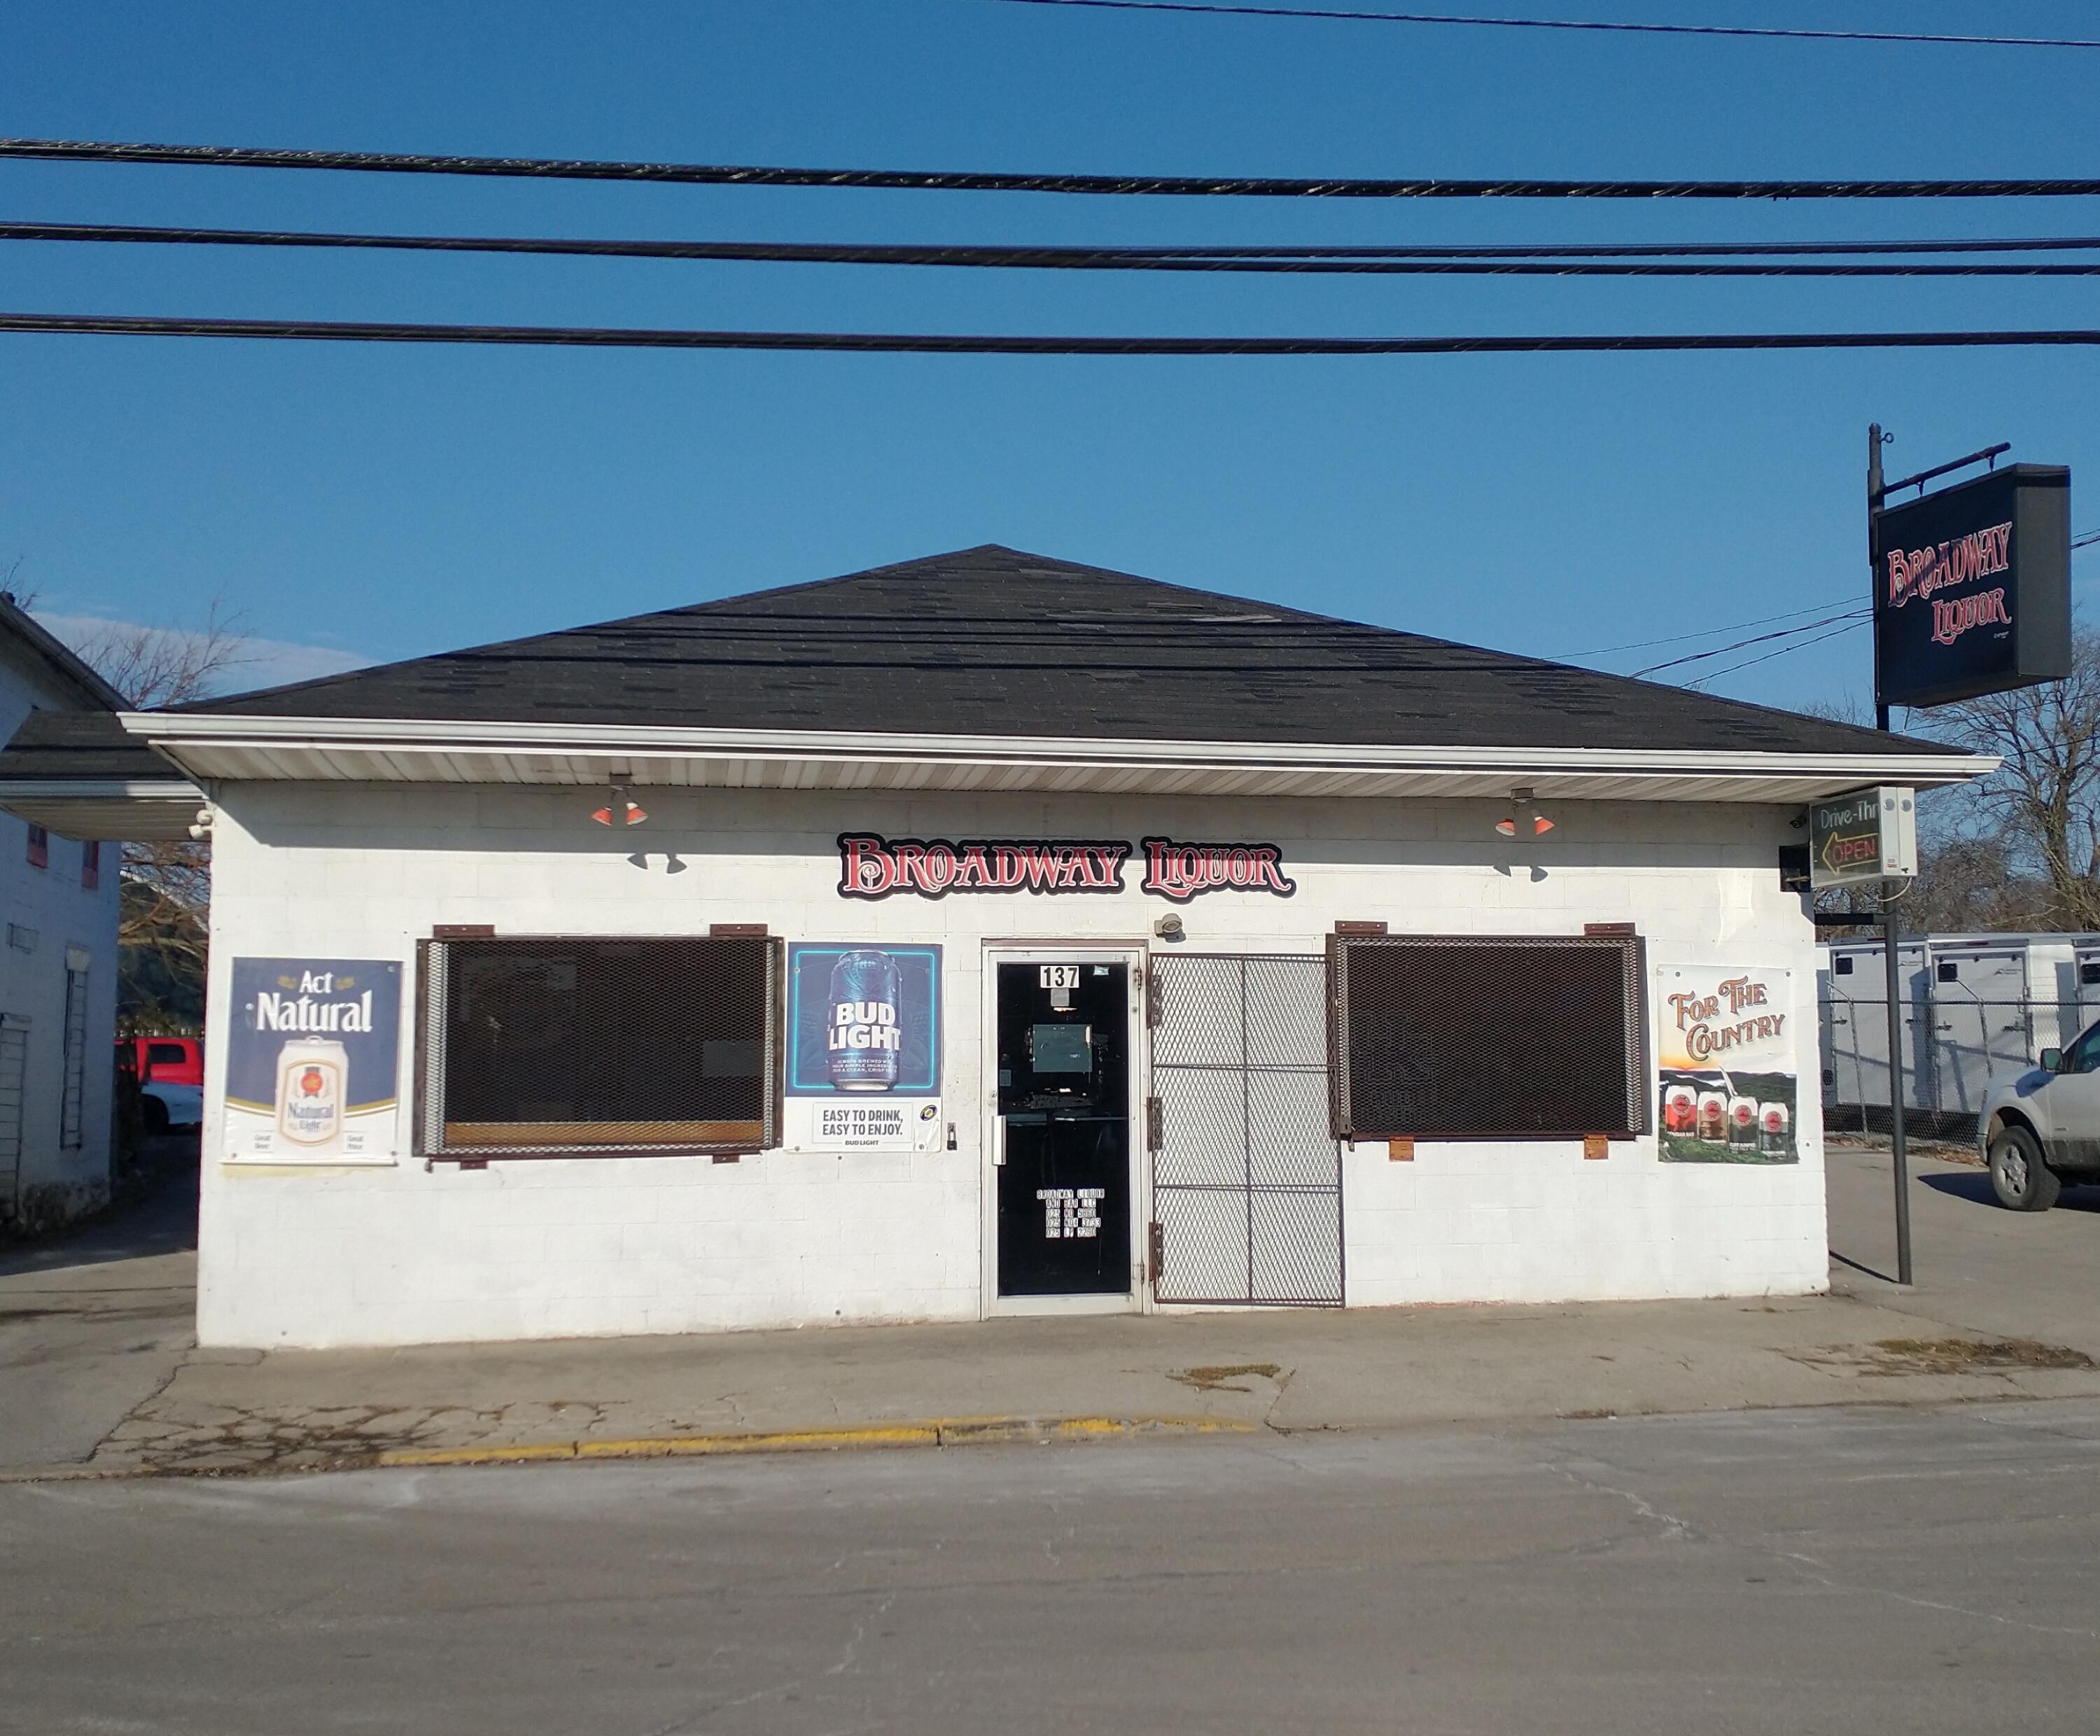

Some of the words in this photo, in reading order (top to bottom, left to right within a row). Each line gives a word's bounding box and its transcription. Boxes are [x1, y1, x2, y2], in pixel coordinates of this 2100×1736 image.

[1888, 522, 2012, 608] BROADWAY
[1931, 587, 2012, 645] LIQUOR
[1833, 839, 1875, 864] OPEN
[843, 838, 1126, 893] BROADWAY
[1144, 841, 1292, 897] LIQUOR
[299, 969, 334, 994] Act
[1043, 966, 1078, 987] 137
[255, 989, 374, 1033] Natural
[836, 1002, 896, 1026] BUD
[1667, 990, 1720, 1032] FOR
[1718, 975, 1768, 1015] THE
[829, 1024, 902, 1051] LIGHT
[1686, 1014, 1786, 1062] COUNTRY
[822, 1110, 850, 1121] EASY
[852, 1110, 866, 1121] TO
[868, 1110, 903, 1124] DRINK,
[822, 1124, 850, 1135] EASY
[852, 1124, 866, 1135] TO
[868, 1124, 903, 1135] ENJOY.
[1046, 1198, 1060, 1208] AND
[1078, 1189, 1105, 1198] LIQUOR
